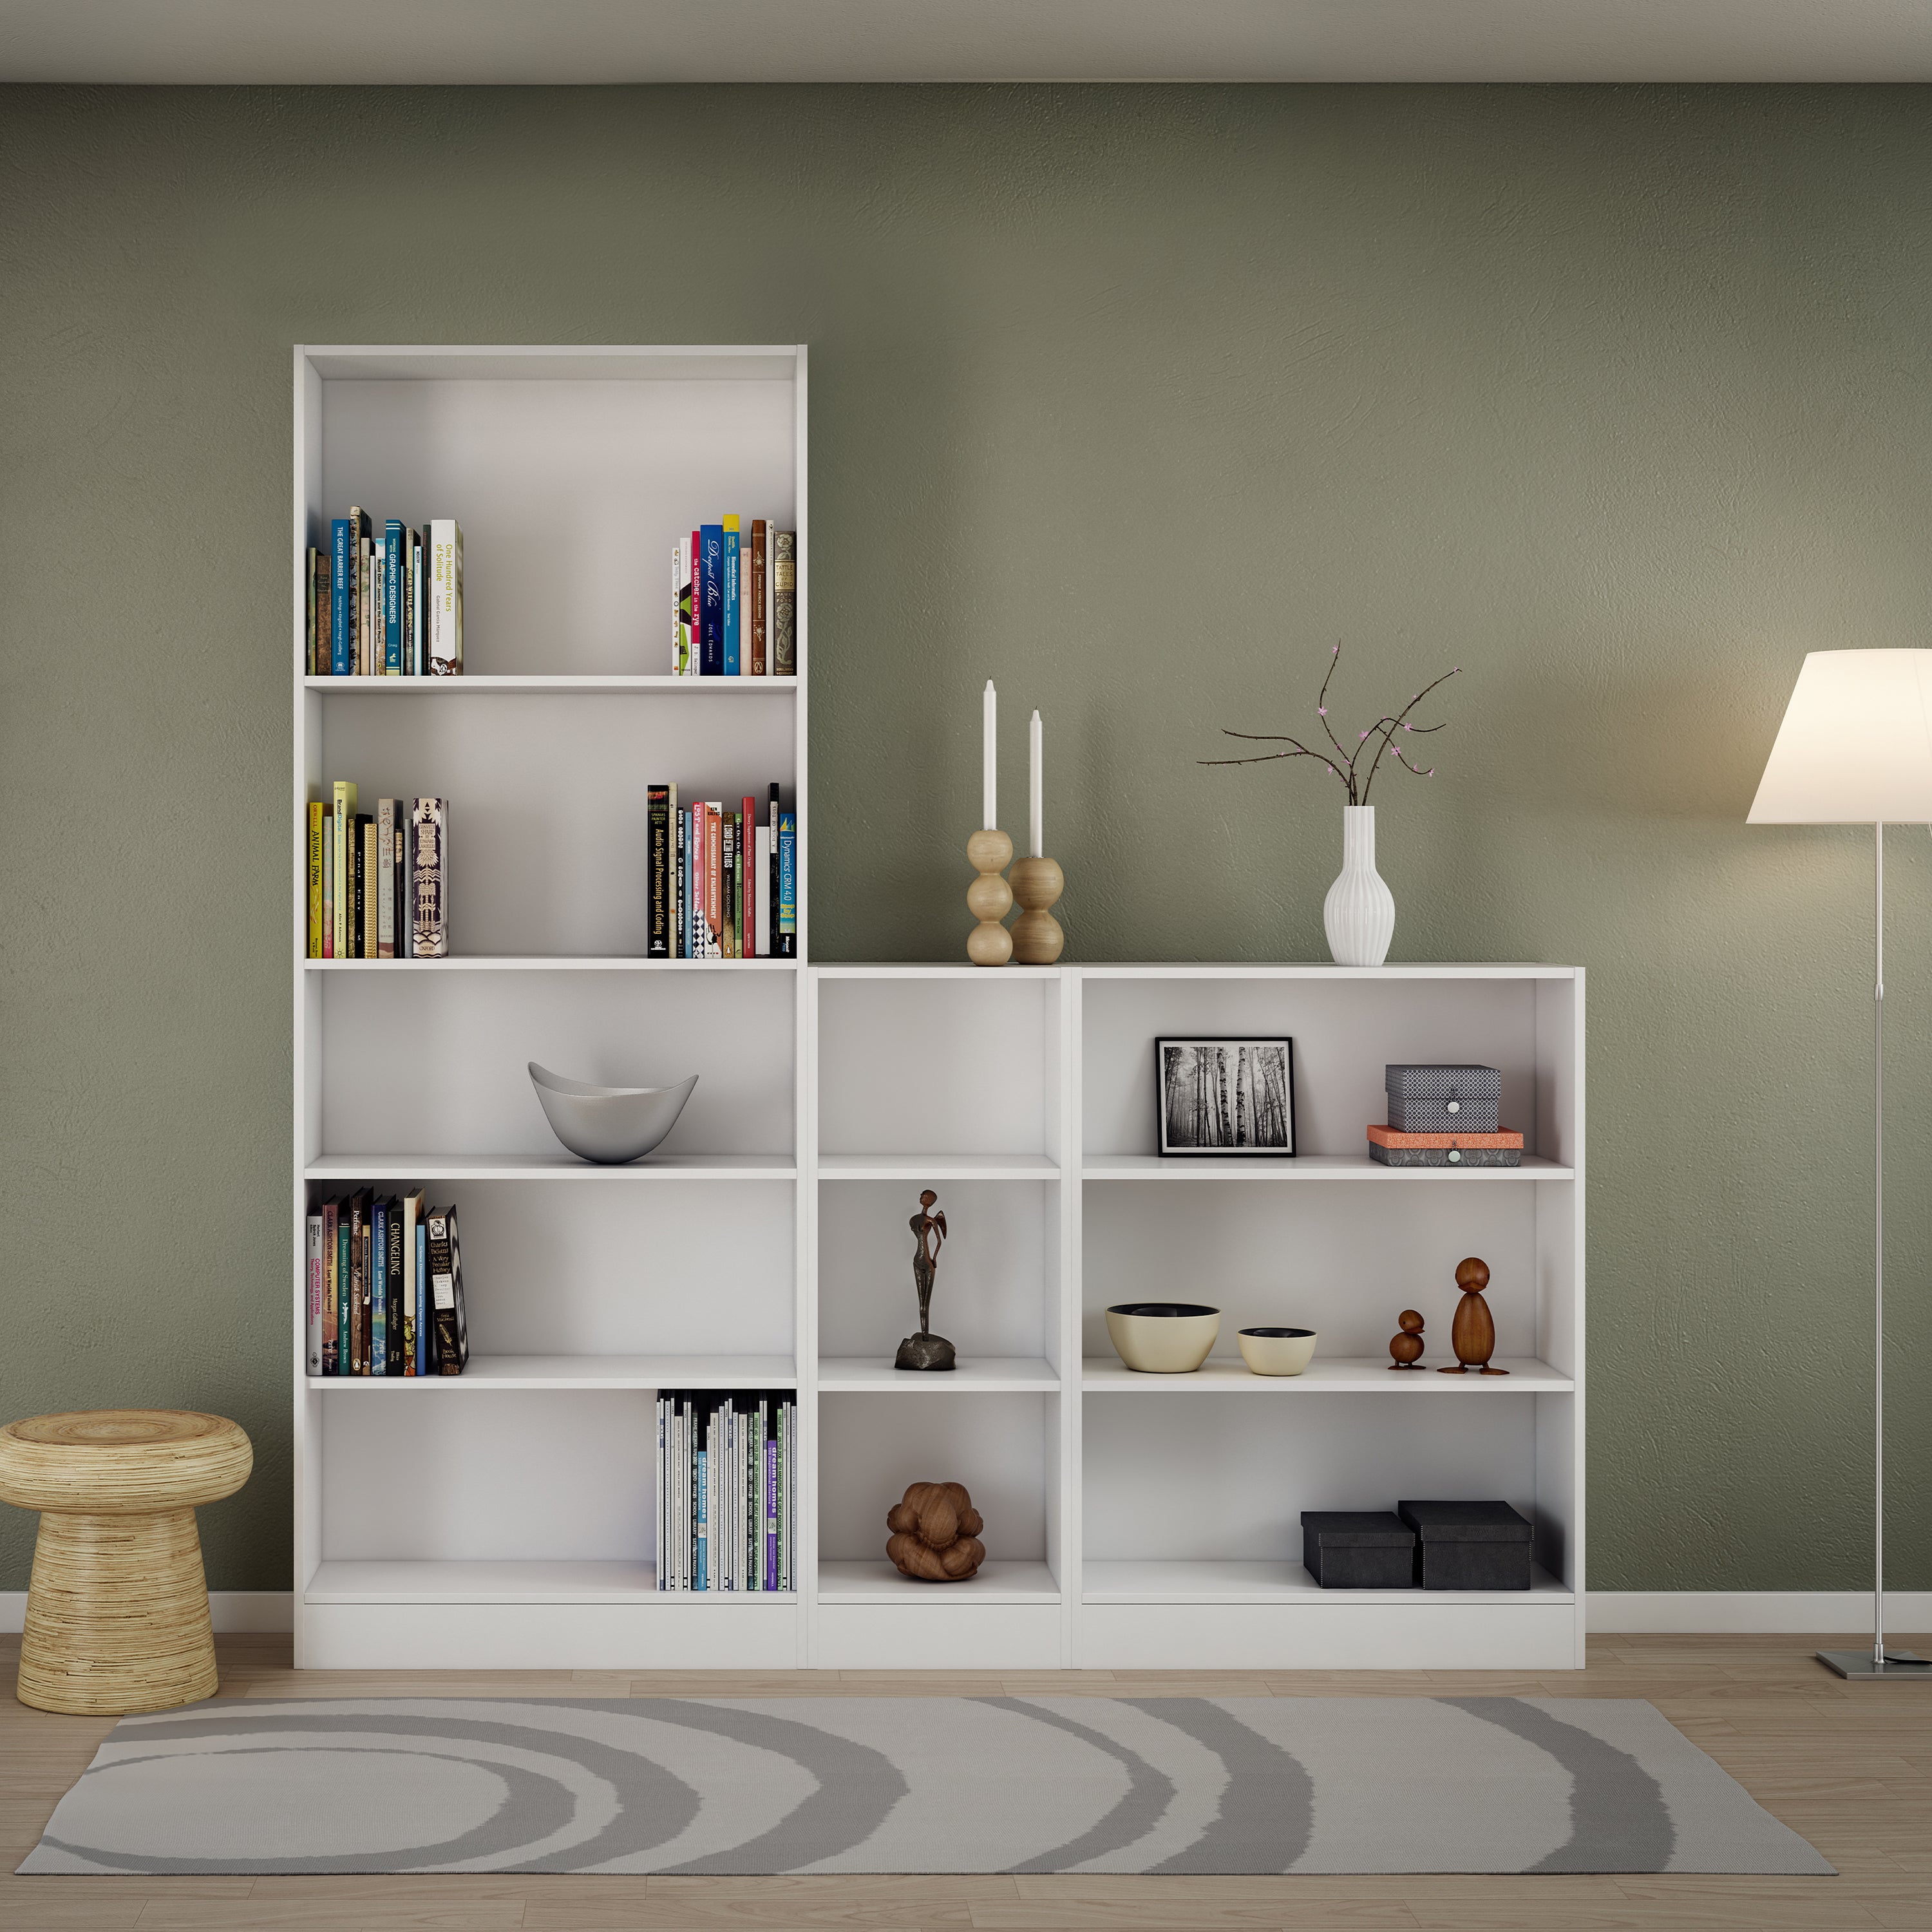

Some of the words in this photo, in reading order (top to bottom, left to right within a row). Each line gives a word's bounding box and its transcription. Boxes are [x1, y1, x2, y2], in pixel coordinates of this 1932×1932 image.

[702, 539, 719, 579] Deepest
[708, 581, 720, 607] Blue
[656, 829, 664, 846] Audio
[724, 824, 733, 838] LORD
[654, 848, 664, 866] Signal
[782, 840, 791, 871] Dynamics
[653, 868, 664, 899] Processing
[656, 901, 664, 912] and
[653, 914, 664, 934] Coding
[391, 1223, 400, 1274] CHANGELING
